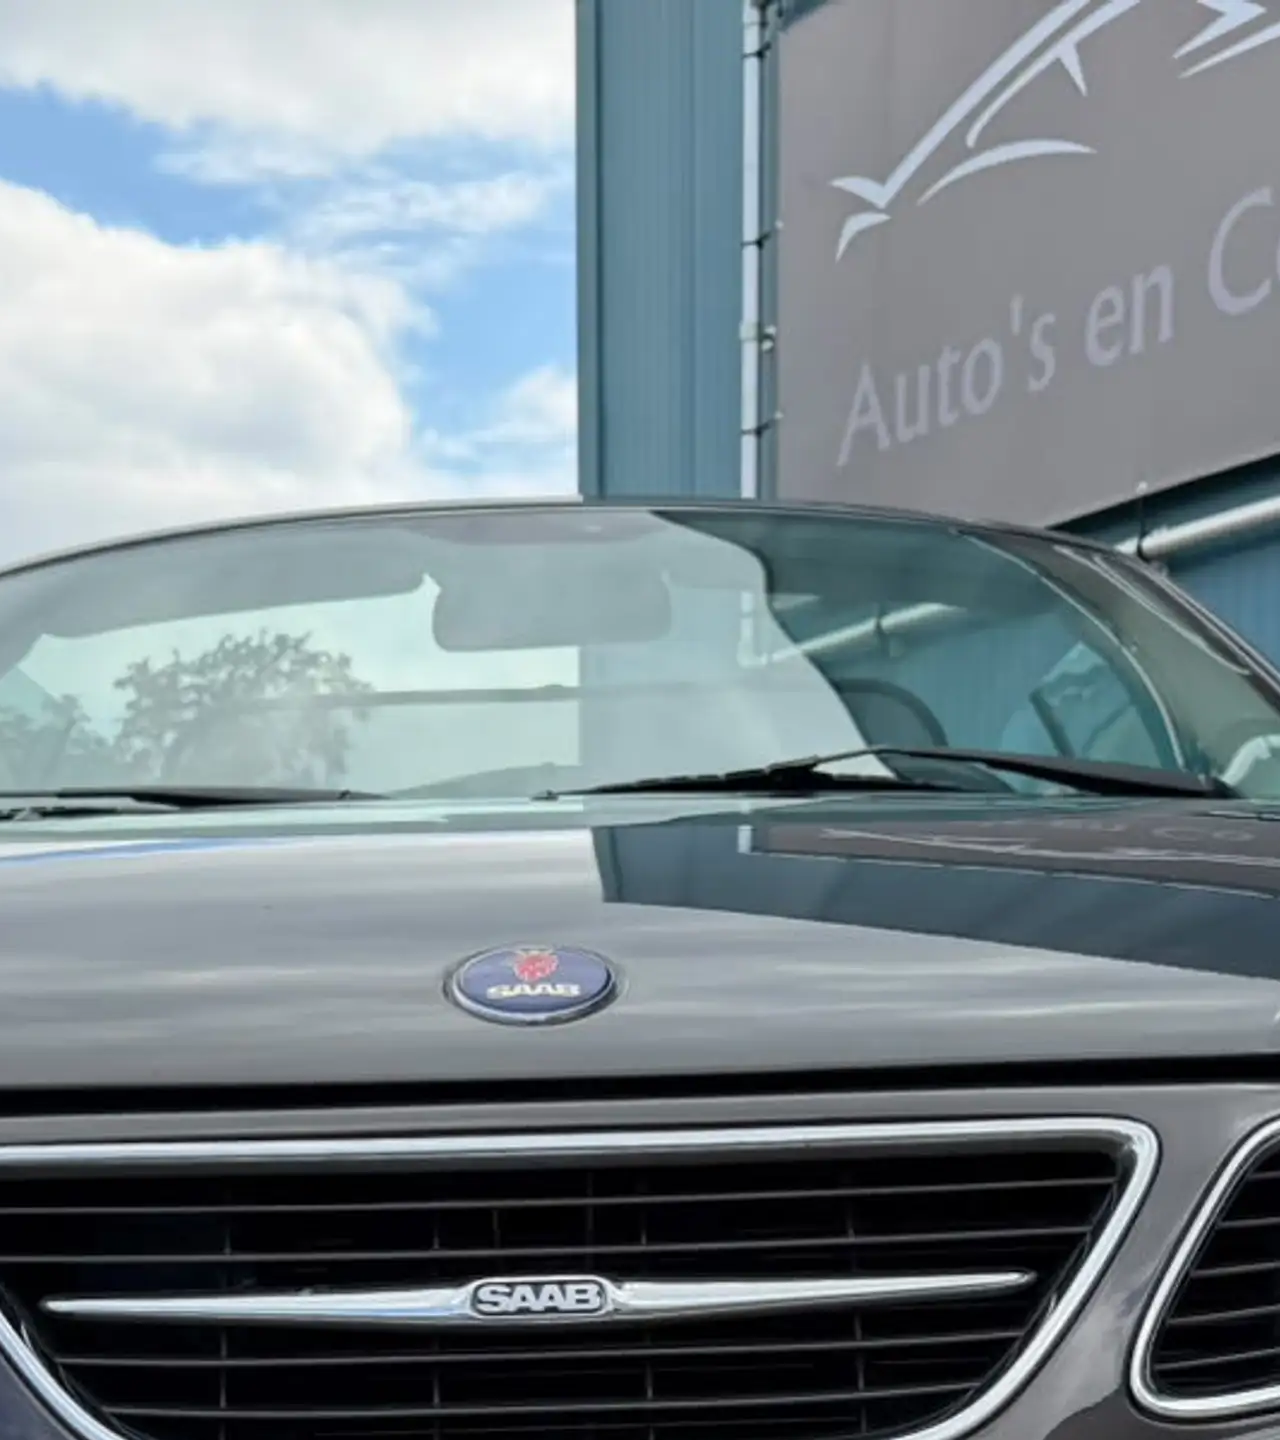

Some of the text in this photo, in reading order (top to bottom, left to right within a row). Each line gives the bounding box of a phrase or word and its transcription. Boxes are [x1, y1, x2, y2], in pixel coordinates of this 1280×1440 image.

[835, 294, 1056, 467] Auto's
[1083, 263, 1175, 365] en
[486, 983, 581, 999] SAAB
[476, 1283, 603, 1313] SAAB
